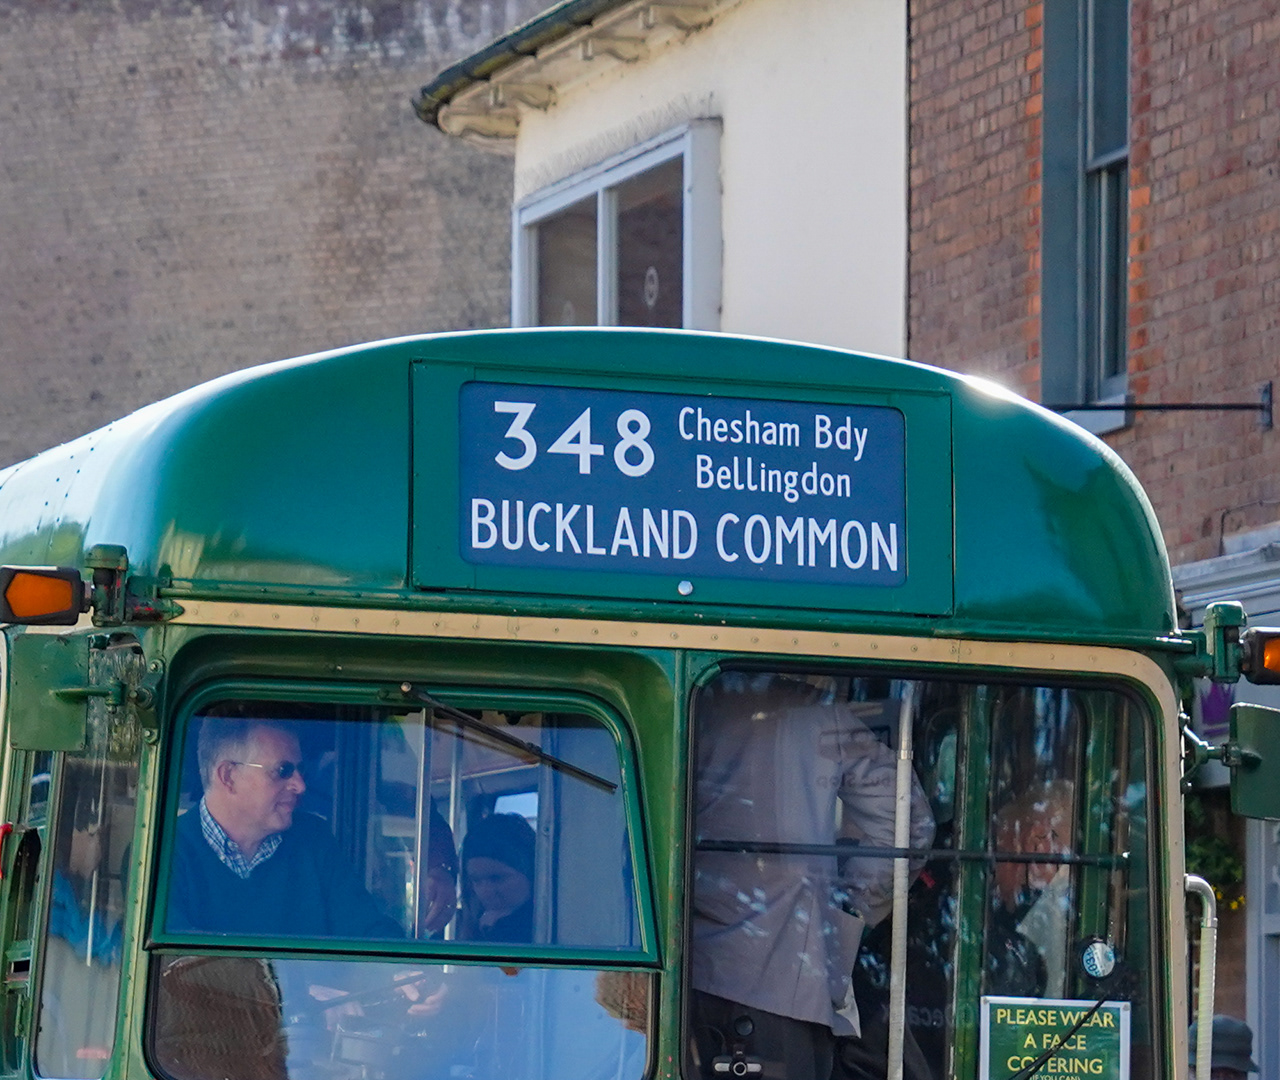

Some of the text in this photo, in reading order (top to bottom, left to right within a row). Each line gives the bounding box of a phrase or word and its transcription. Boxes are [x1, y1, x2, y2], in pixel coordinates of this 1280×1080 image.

[494, 400, 655, 478] 348
[678, 406, 868, 462] Chesham Bdy
[696, 454, 850, 503] Bellingdon
[471, 498, 898, 572] BUCKLAND COMMON
[996, 1008, 1114, 1028] PLEASE WEAR
[1024, 1033, 1086, 1050] A FACE
